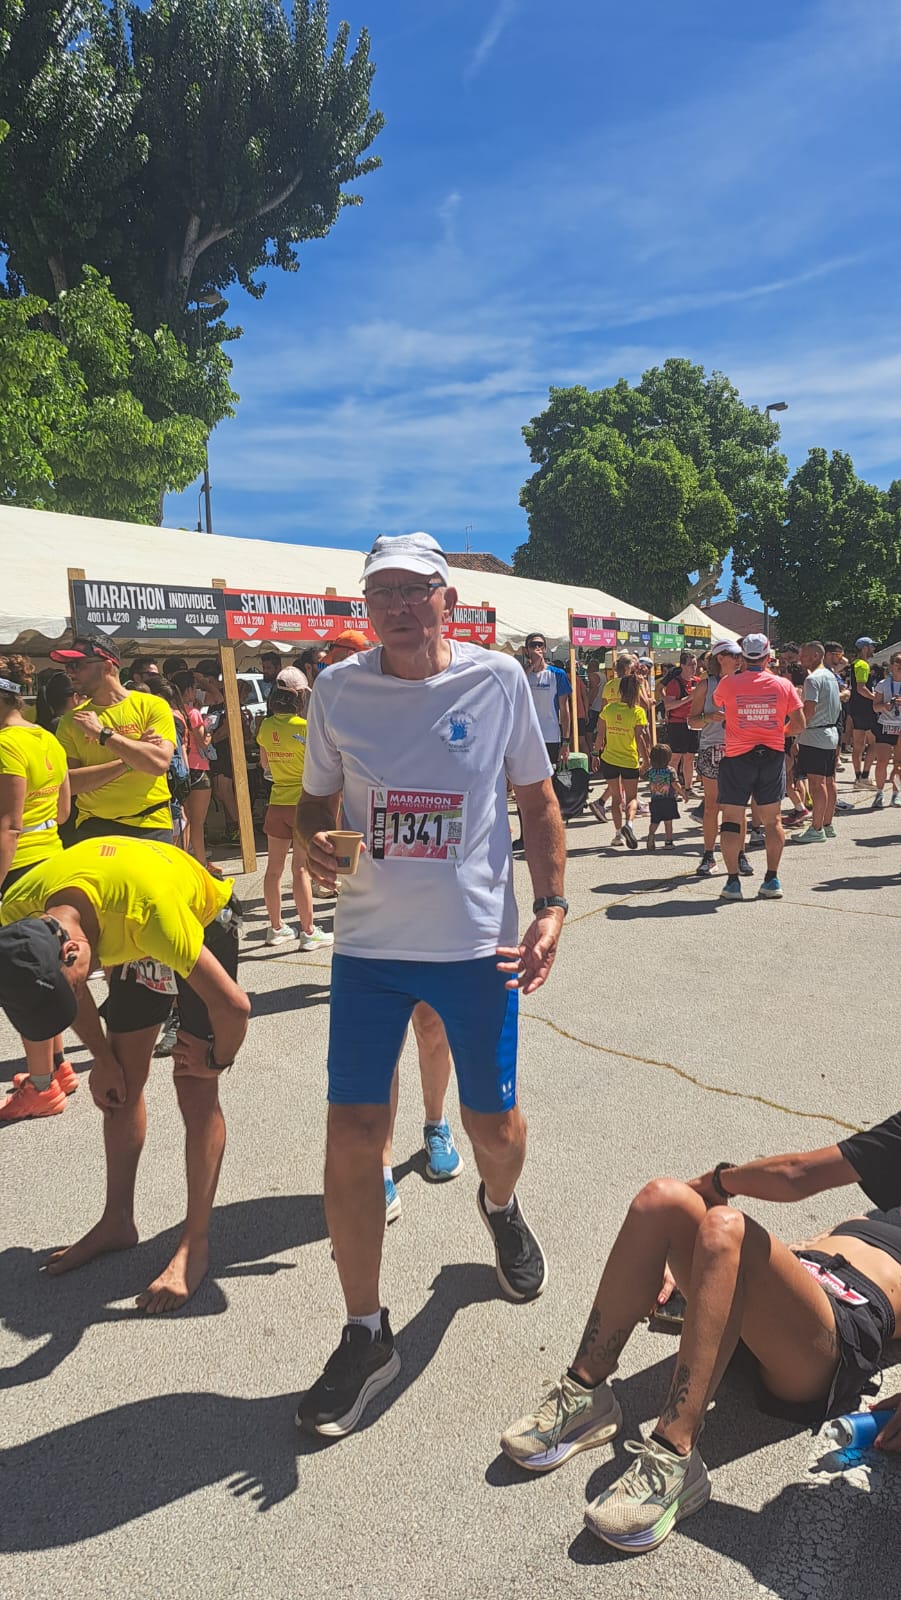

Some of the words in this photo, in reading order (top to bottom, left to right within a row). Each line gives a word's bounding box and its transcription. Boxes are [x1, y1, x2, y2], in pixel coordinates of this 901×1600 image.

[85, 583, 165, 610] MARATHON
[168, 592, 217, 610] INDIVIDUEL
[240, 593, 269, 614] SEMI
[270, 595, 325, 616] MARATHON
[87, 612, 105, 623] 4001
[113, 612, 130, 623] 4230
[350, 600, 368, 619] SEM
[389, 794, 451, 805] MARATHON
[374, 812, 385, 829] km
[391, 811, 443, 847] 1341
[374, 829, 384, 849] 10,6
